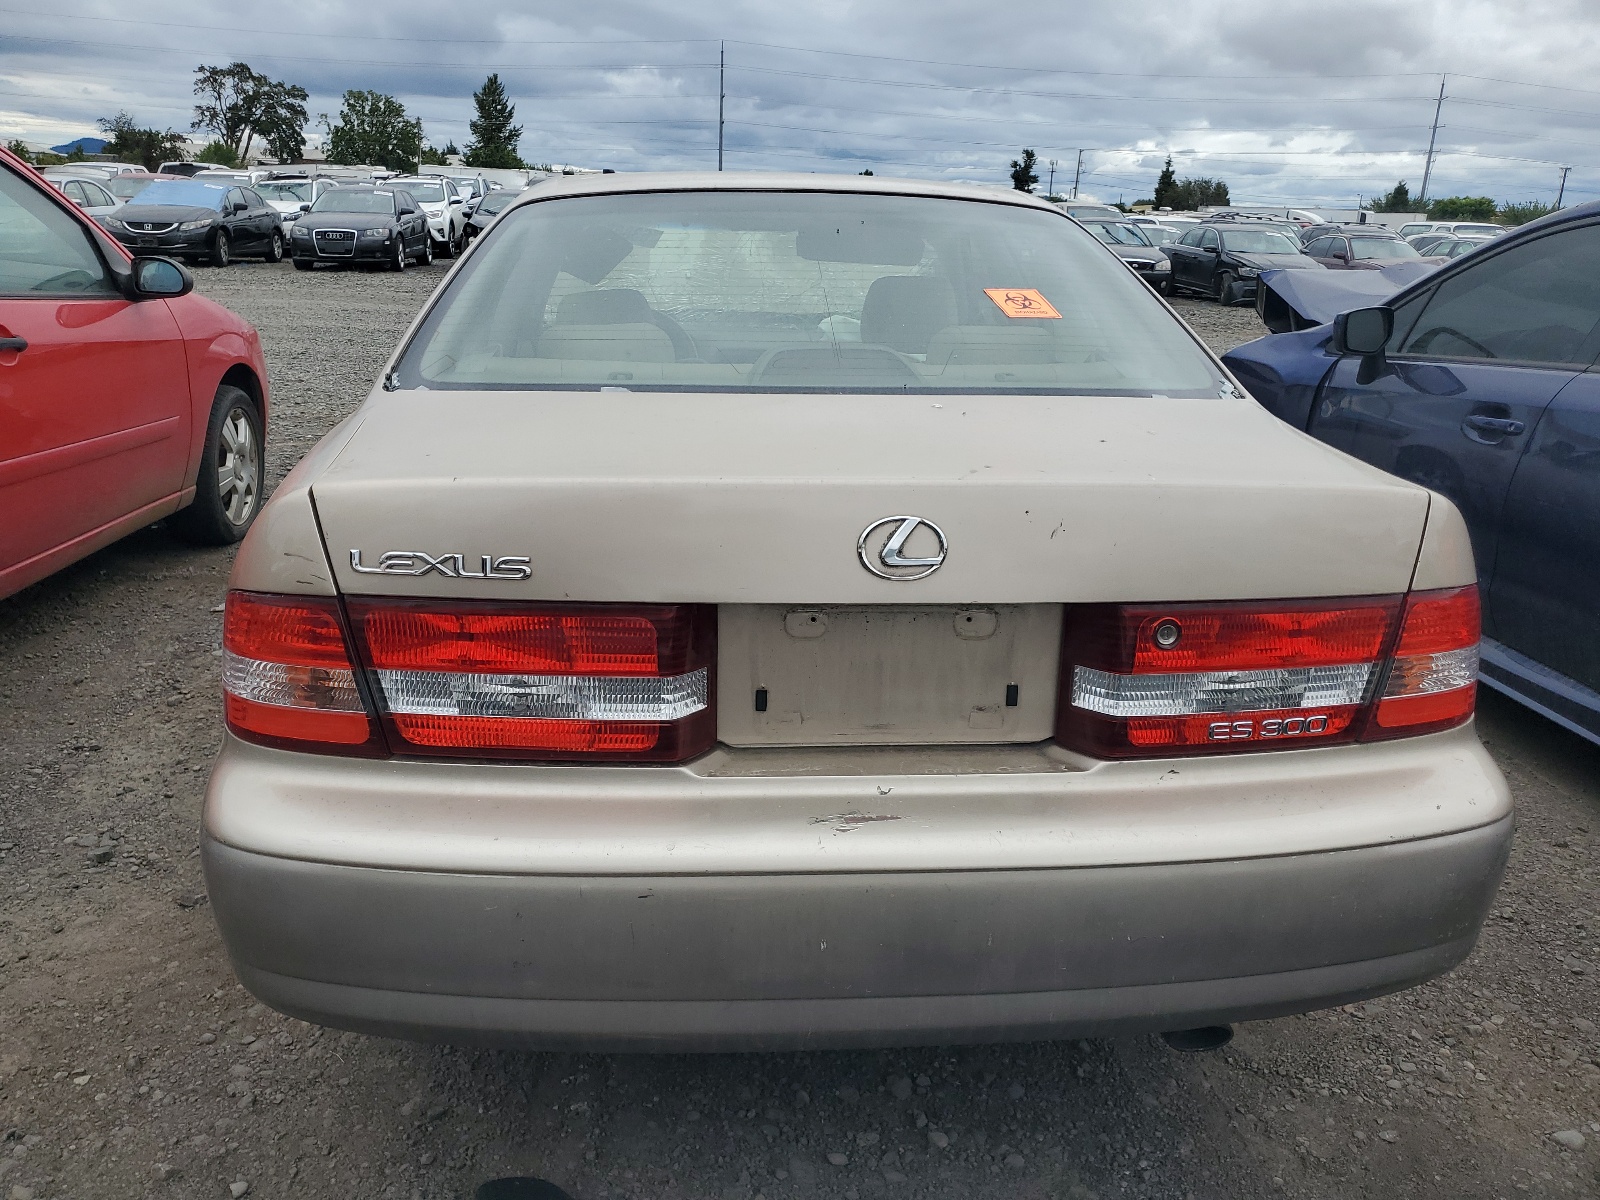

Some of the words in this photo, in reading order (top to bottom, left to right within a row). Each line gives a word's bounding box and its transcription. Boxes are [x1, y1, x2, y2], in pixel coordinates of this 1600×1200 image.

[349, 549, 532, 579] LEXUS
[1208, 721, 1253, 740] ES
[1260, 715, 1328, 737] 300
